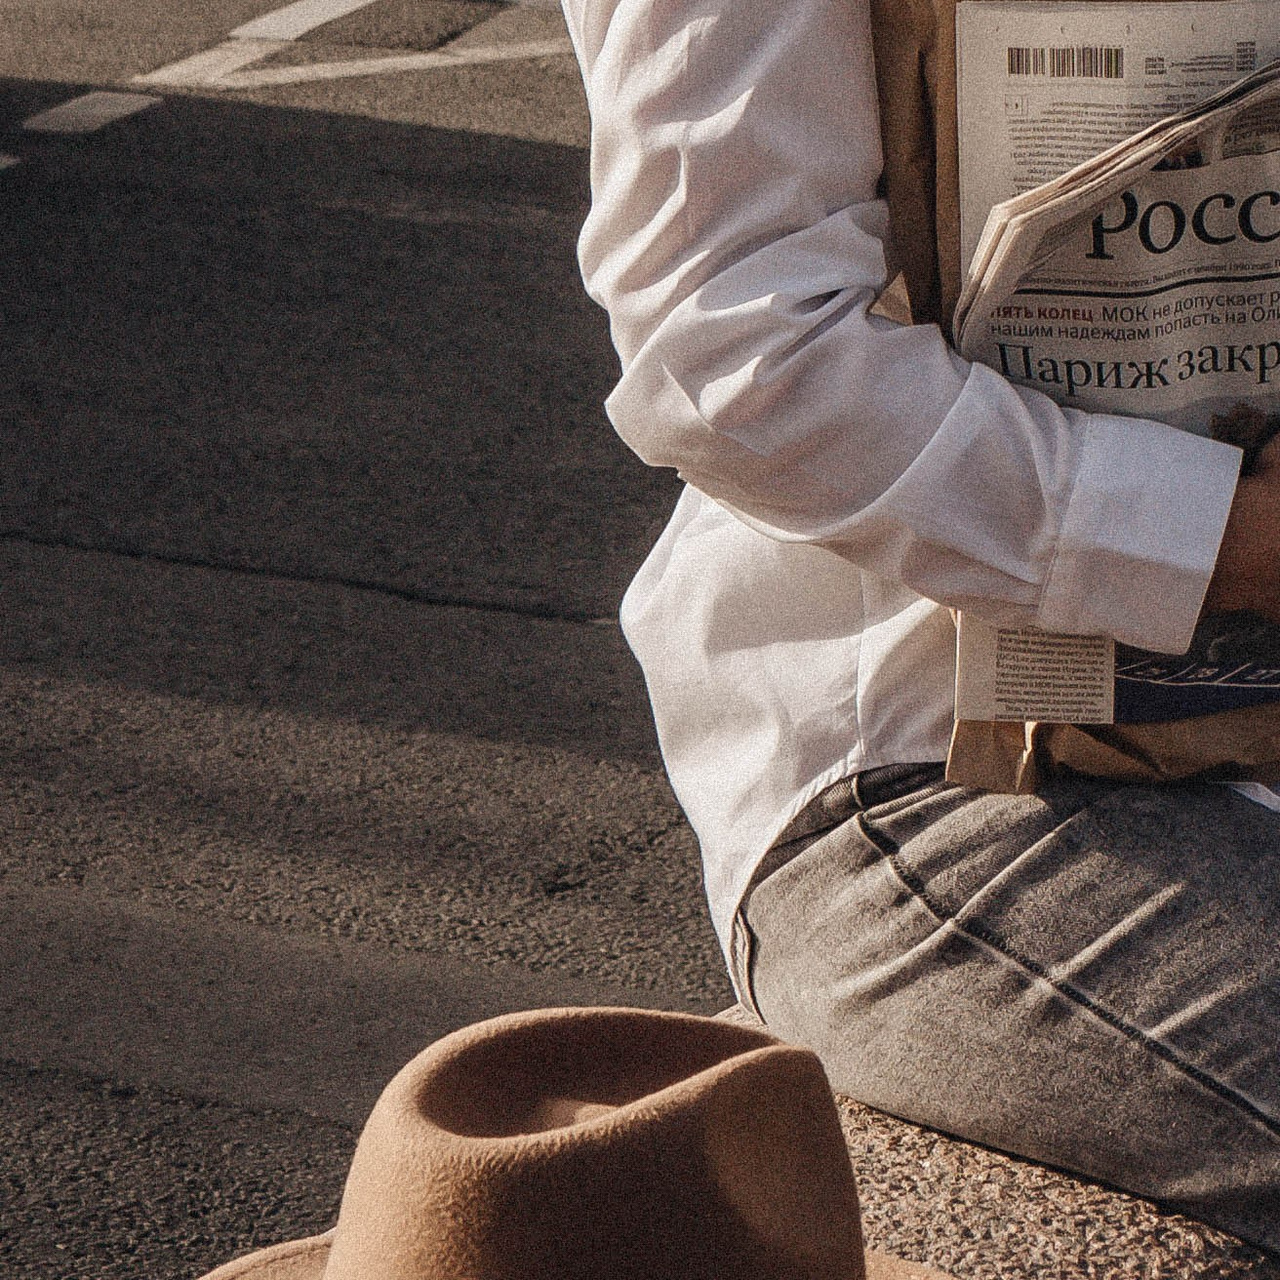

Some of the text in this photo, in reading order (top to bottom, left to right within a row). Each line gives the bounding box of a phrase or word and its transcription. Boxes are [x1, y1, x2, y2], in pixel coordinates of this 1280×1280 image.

[1102, 305, 1148, 323] МОК
[1152, 303, 1170, 319] не
[1173, 292, 1266, 316] допускает
[991, 324, 1053, 338] нашим
[1058, 325, 1150, 342] надеждам
[1154, 313, 1221, 338] попасть
[1224, 308, 1247, 325] на
[996, 342, 1170, 397] Париж
